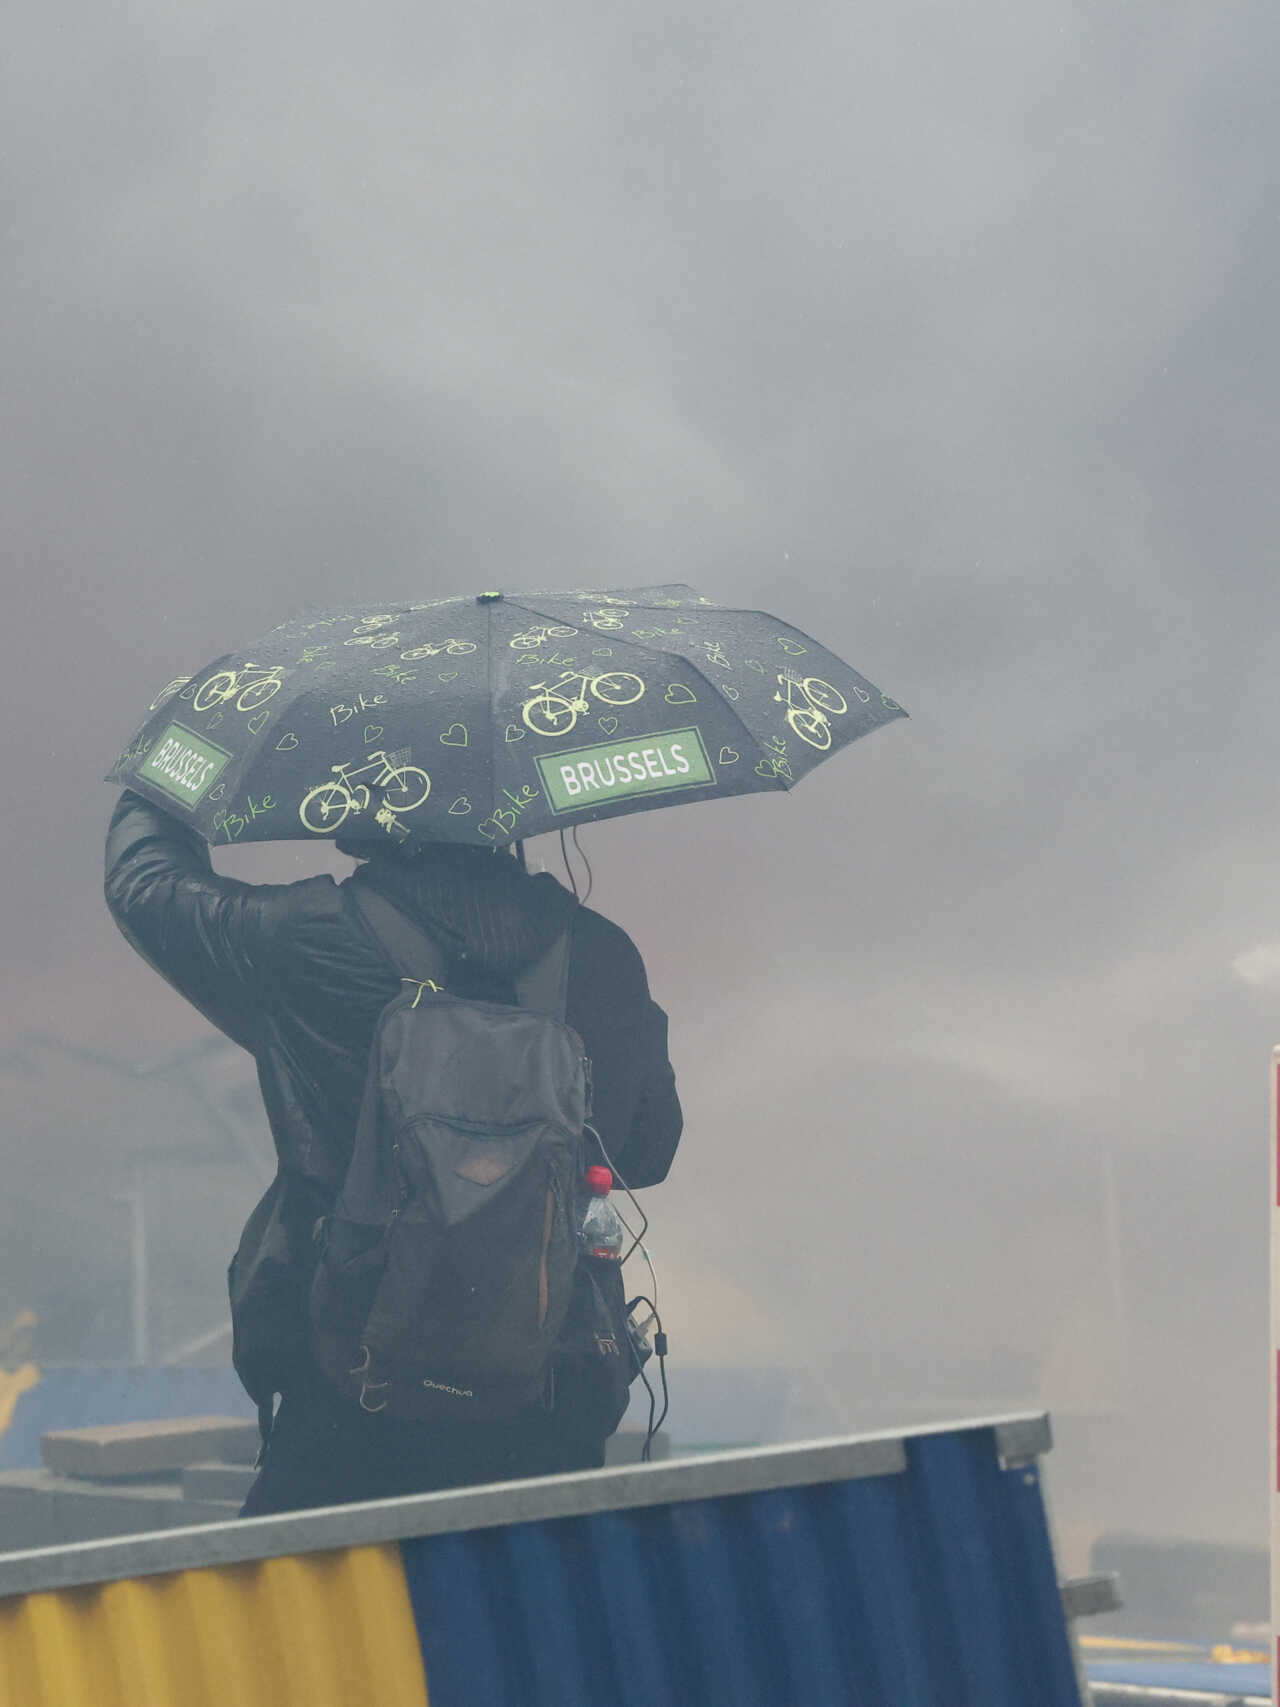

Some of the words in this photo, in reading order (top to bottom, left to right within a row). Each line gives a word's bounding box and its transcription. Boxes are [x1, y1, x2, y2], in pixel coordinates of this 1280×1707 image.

[514, 652, 577, 667] Bike
[329, 692, 389, 726] Bike
[151, 738, 214, 791] BRUSSELS
[559, 744, 691, 796] BRUSSELS
[223, 792, 276, 840] Bike
[493, 783, 539, 834] Bike
